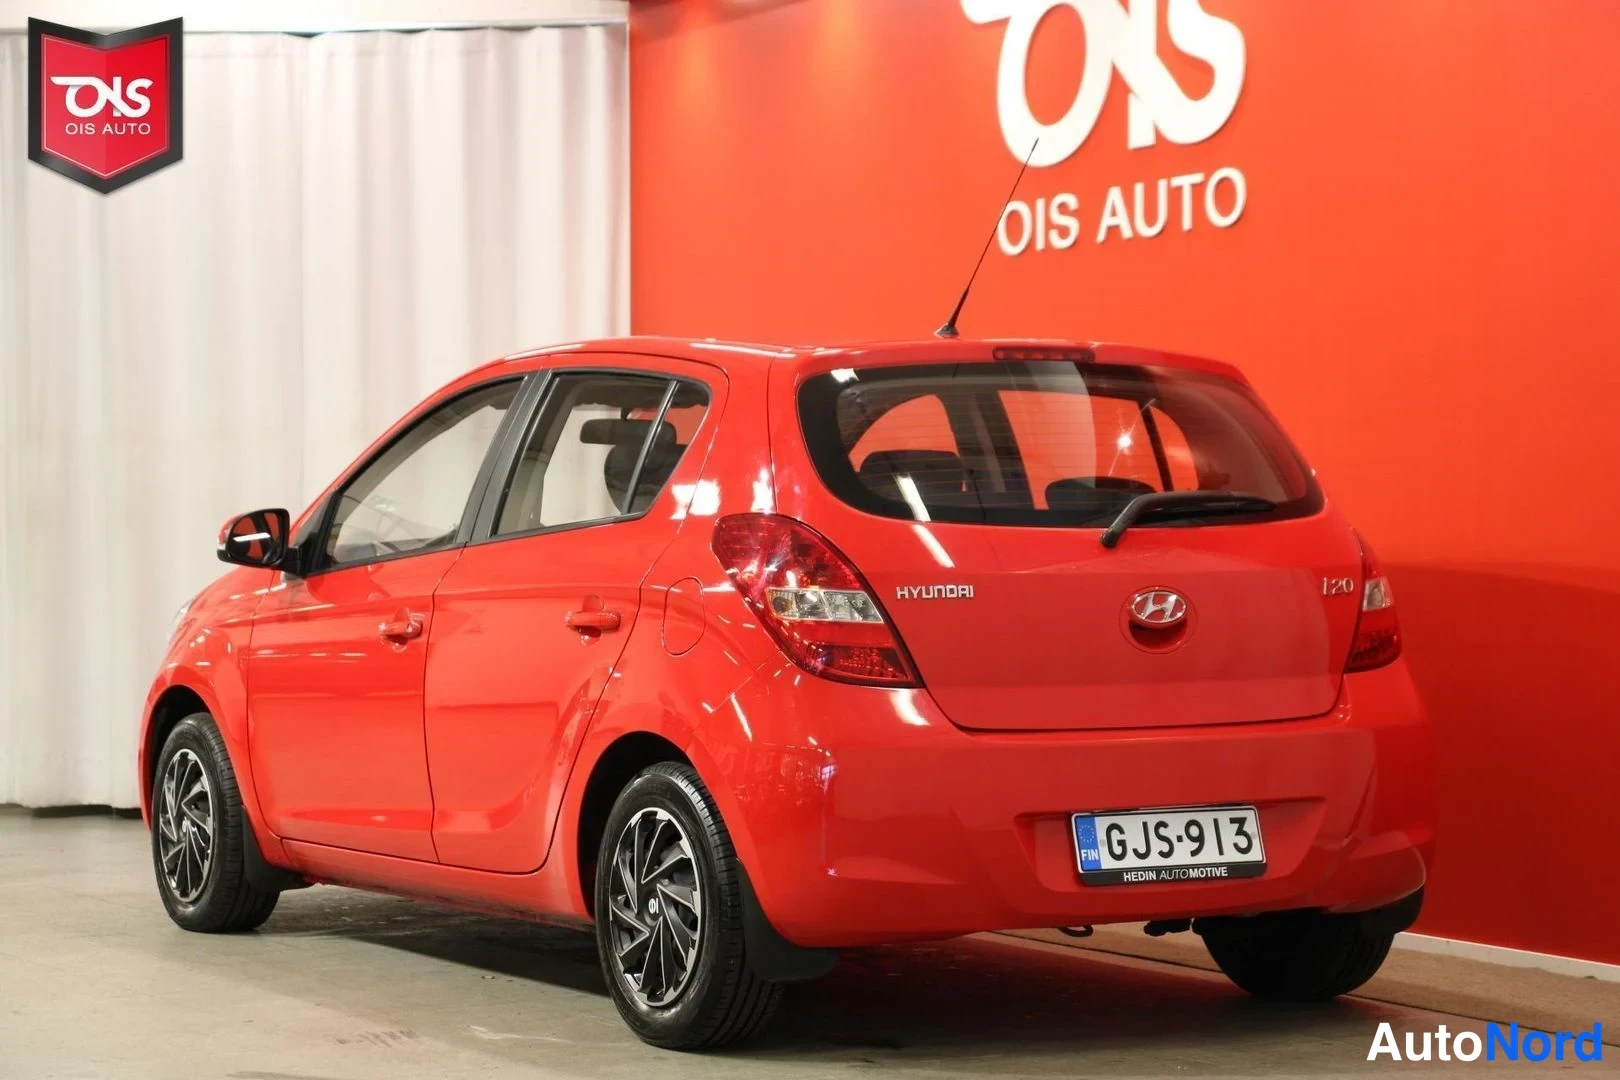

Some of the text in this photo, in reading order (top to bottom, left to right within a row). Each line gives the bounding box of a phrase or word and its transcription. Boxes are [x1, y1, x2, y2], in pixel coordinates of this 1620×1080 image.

[997, 167, 1247, 257] OIS AUTO
[896, 585, 974, 599] HYUNDAI
[1081, 849, 1099, 861] FIN
[1123, 867, 1228, 882] HEDIN AUTOMOTIVE
